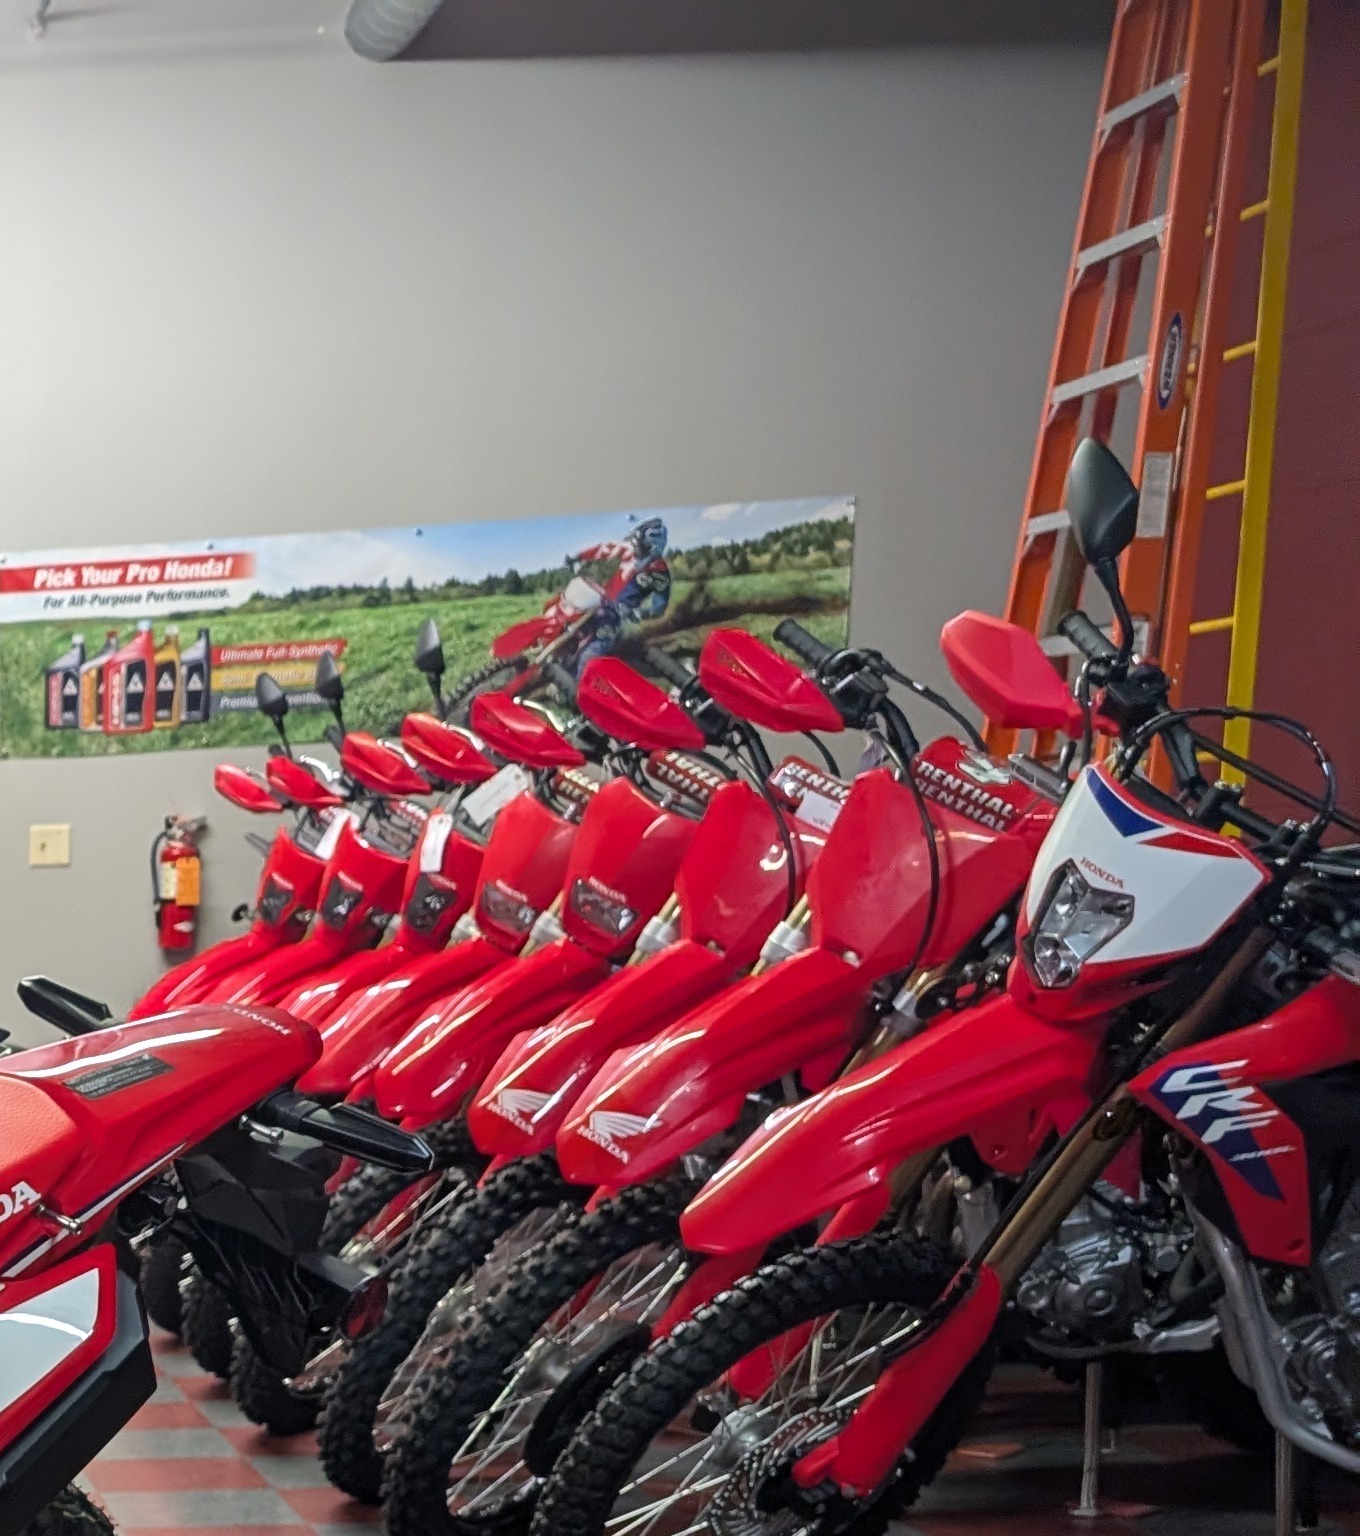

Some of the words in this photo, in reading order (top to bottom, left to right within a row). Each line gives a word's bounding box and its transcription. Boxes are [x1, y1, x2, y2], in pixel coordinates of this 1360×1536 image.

[34, 568, 77, 588] Pick
[80, 566, 123, 586] Your
[126, 563, 161, 584] Pro
[163, 557, 233, 581] Honda!
[43, 595, 63, 609] For
[917, 761, 1013, 819] RENTHAL
[1080, 857, 1124, 889] HONDA
